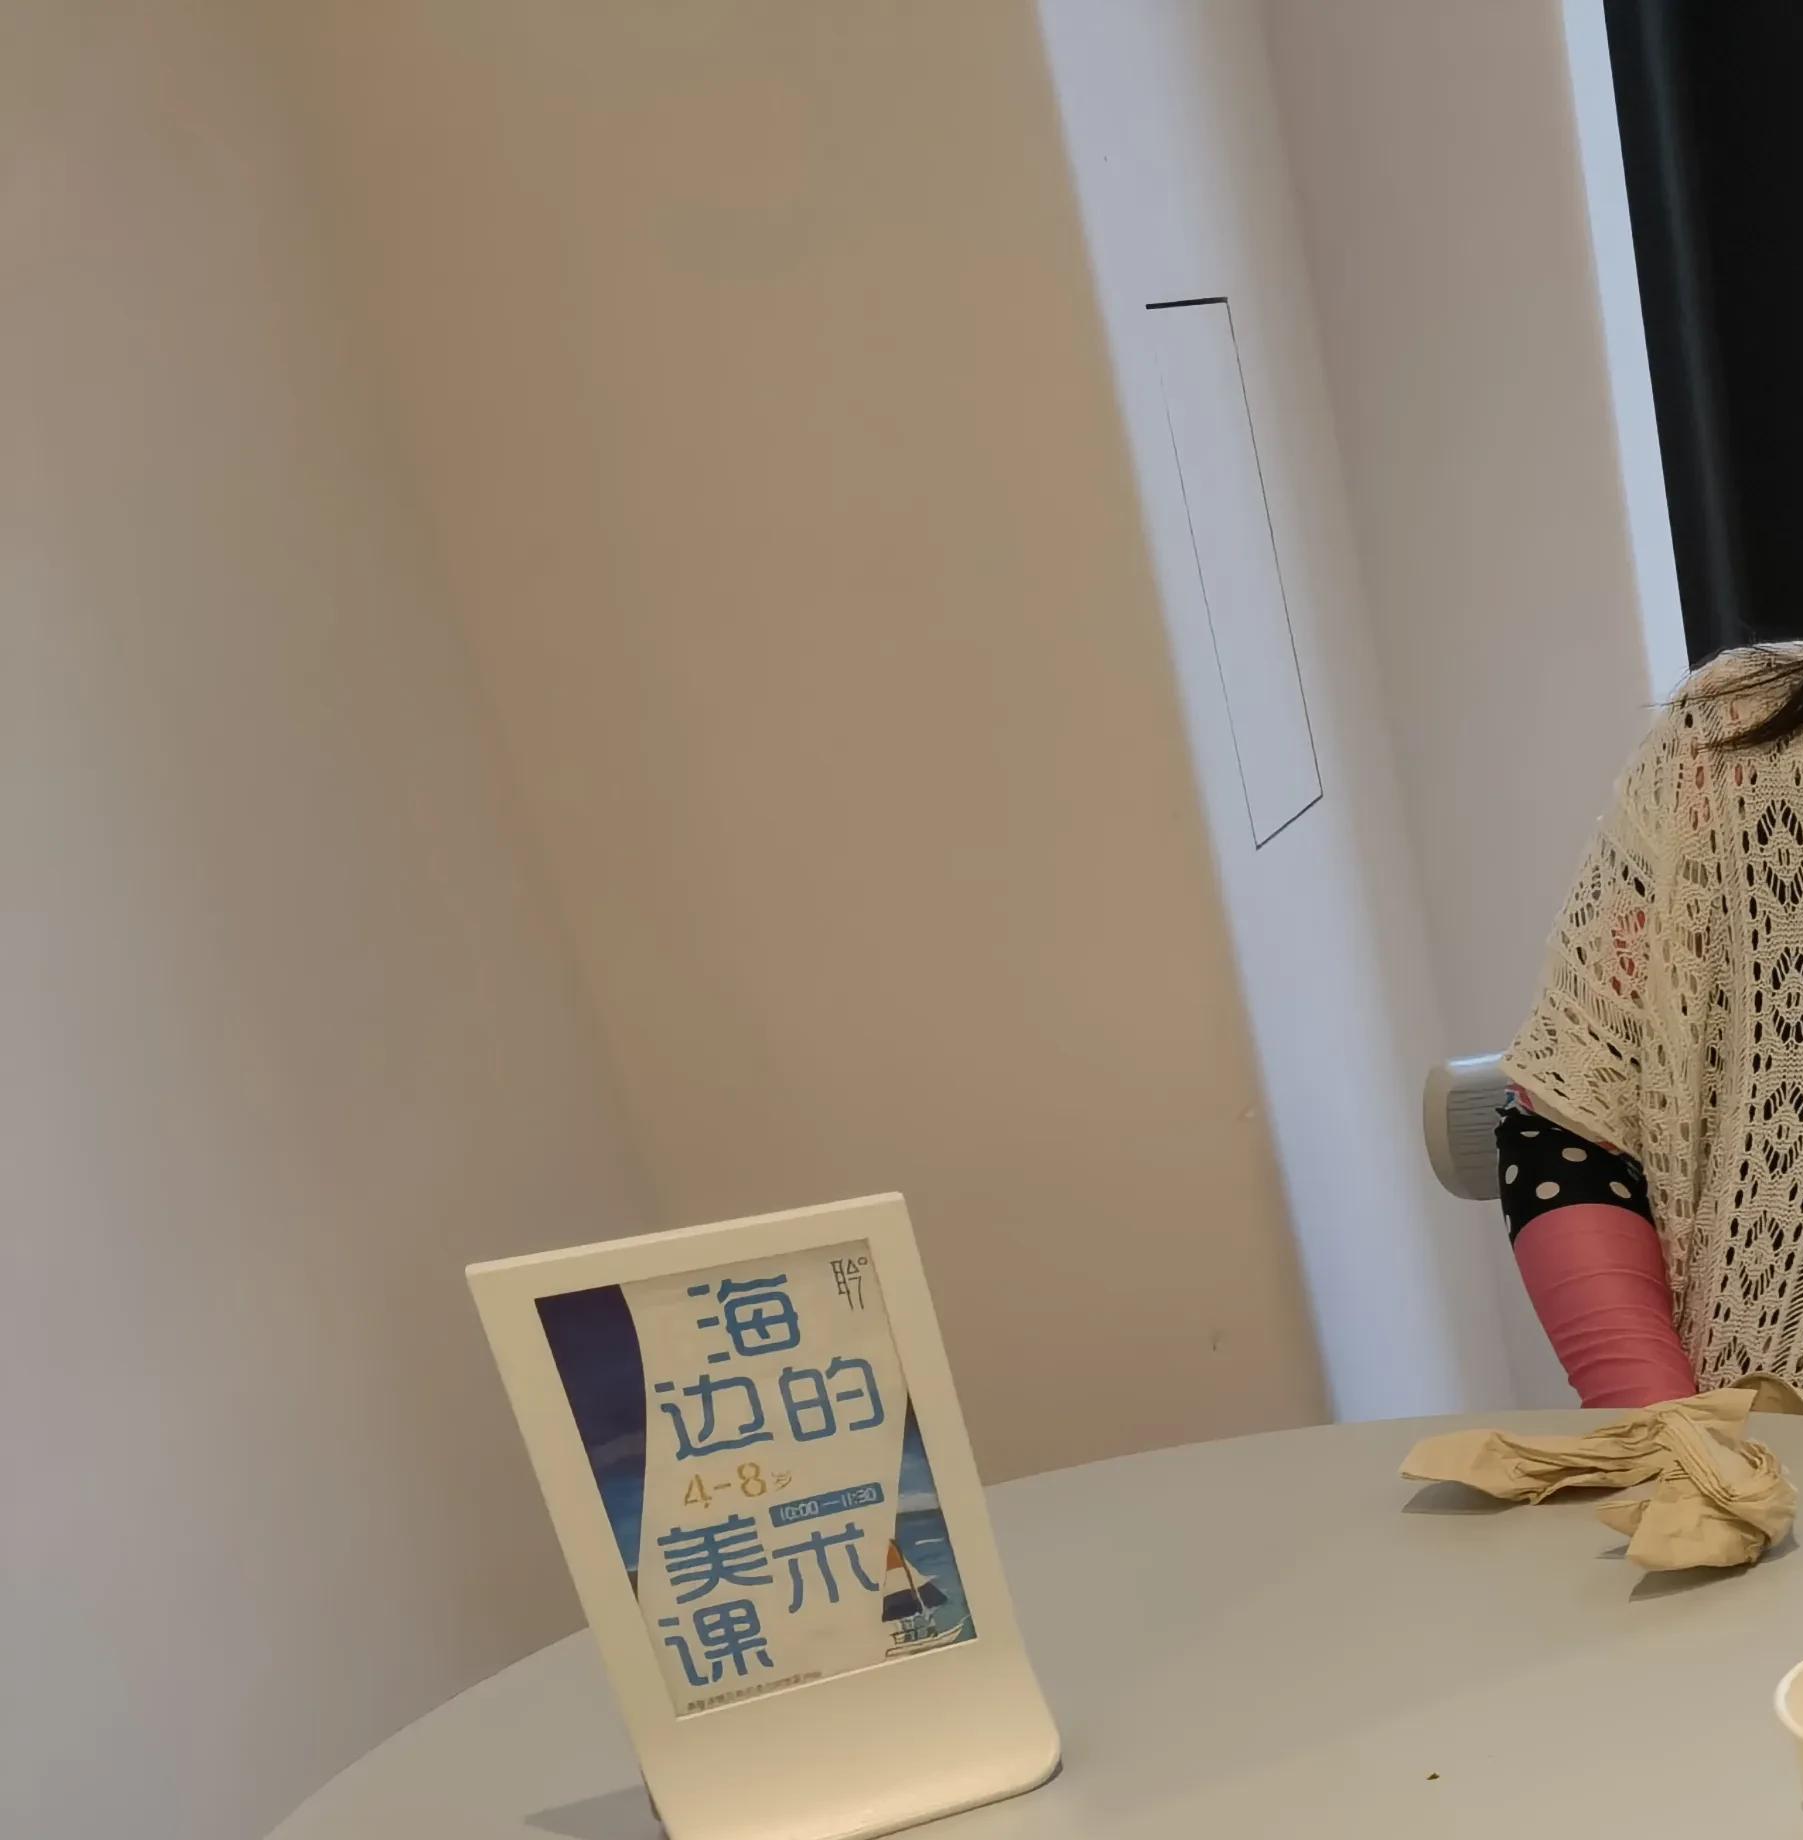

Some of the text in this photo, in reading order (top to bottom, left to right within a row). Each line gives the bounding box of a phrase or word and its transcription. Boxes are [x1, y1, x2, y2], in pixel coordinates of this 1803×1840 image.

[687, 1274, 801, 1364] 海
[654, 1356, 885, 1461] 边的
[657, 1513, 880, 1614] 美术
[658, 1598, 775, 1687] 课
